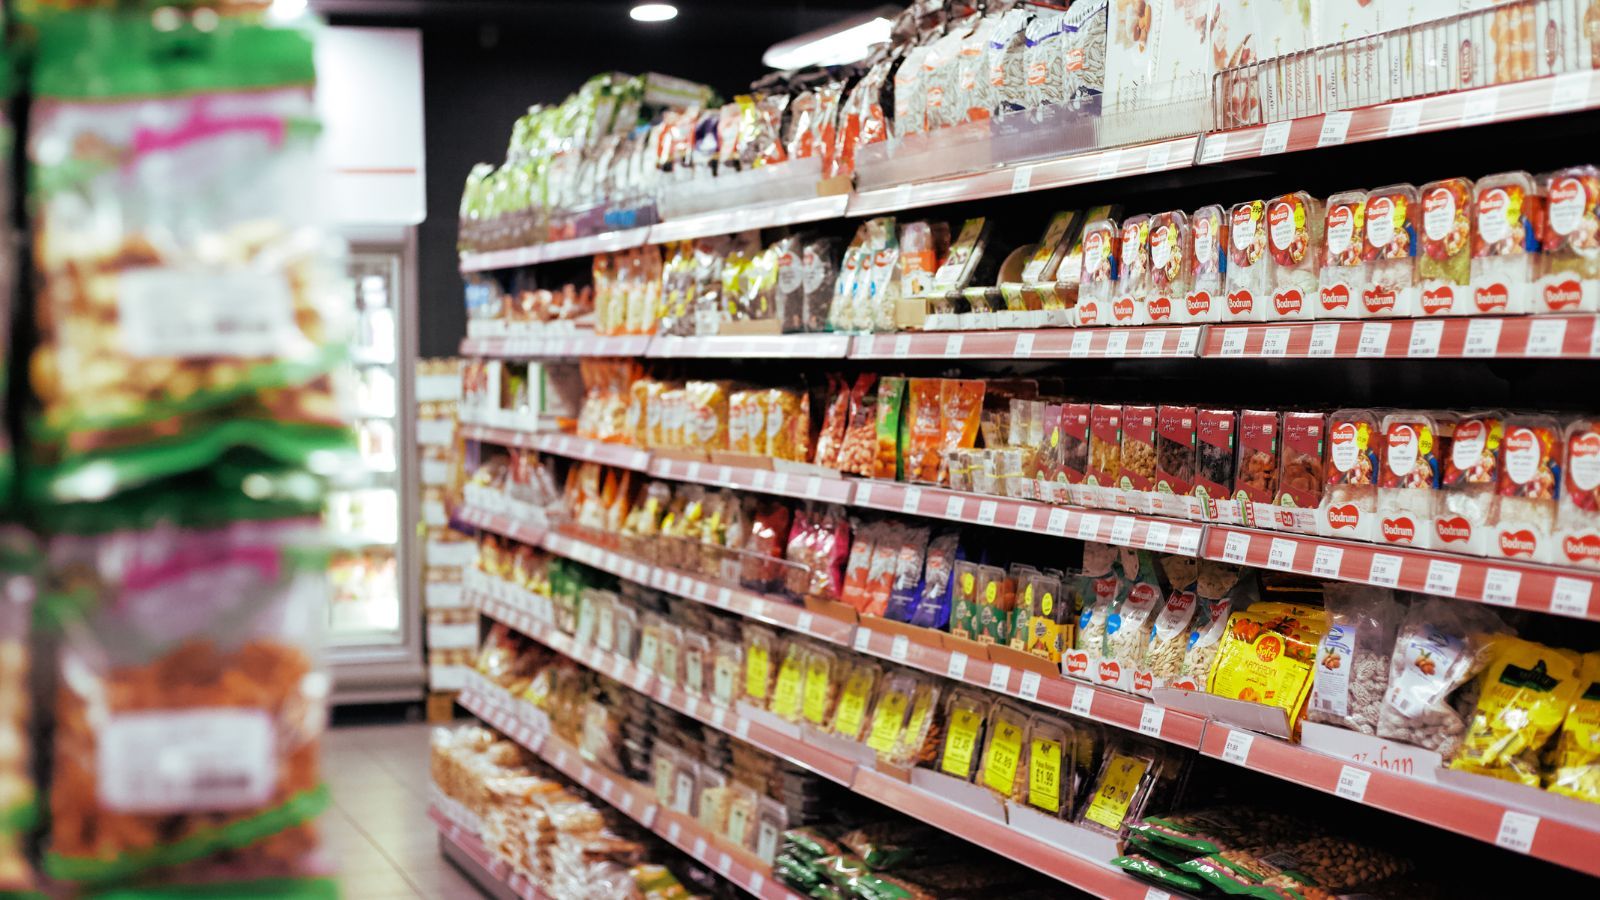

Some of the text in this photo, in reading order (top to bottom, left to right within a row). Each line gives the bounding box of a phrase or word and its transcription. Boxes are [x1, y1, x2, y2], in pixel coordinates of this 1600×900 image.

[1322, 292, 1348, 304] Bodrum
[1365, 295, 1394, 306] Bodrum
[1423, 294, 1452, 307] Bodrum
[1477, 292, 1506, 304] Bodrum
[1546, 289, 1581, 303] Bodrum
[1149, 304, 1170, 314] Bodrum
[1188, 300, 1209, 309] Bodrum
[1228, 298, 1252, 308] Bodrum
[1276, 299, 1302, 309] Bodrum
[1114, 305, 1133, 315] Bodrum
[1329, 511, 1357, 524] Bodrum
[1383, 523, 1413, 537] Bodrum
[1438, 525, 1469, 538] Bodrum
[1501, 537, 1534, 550] Bodrum
